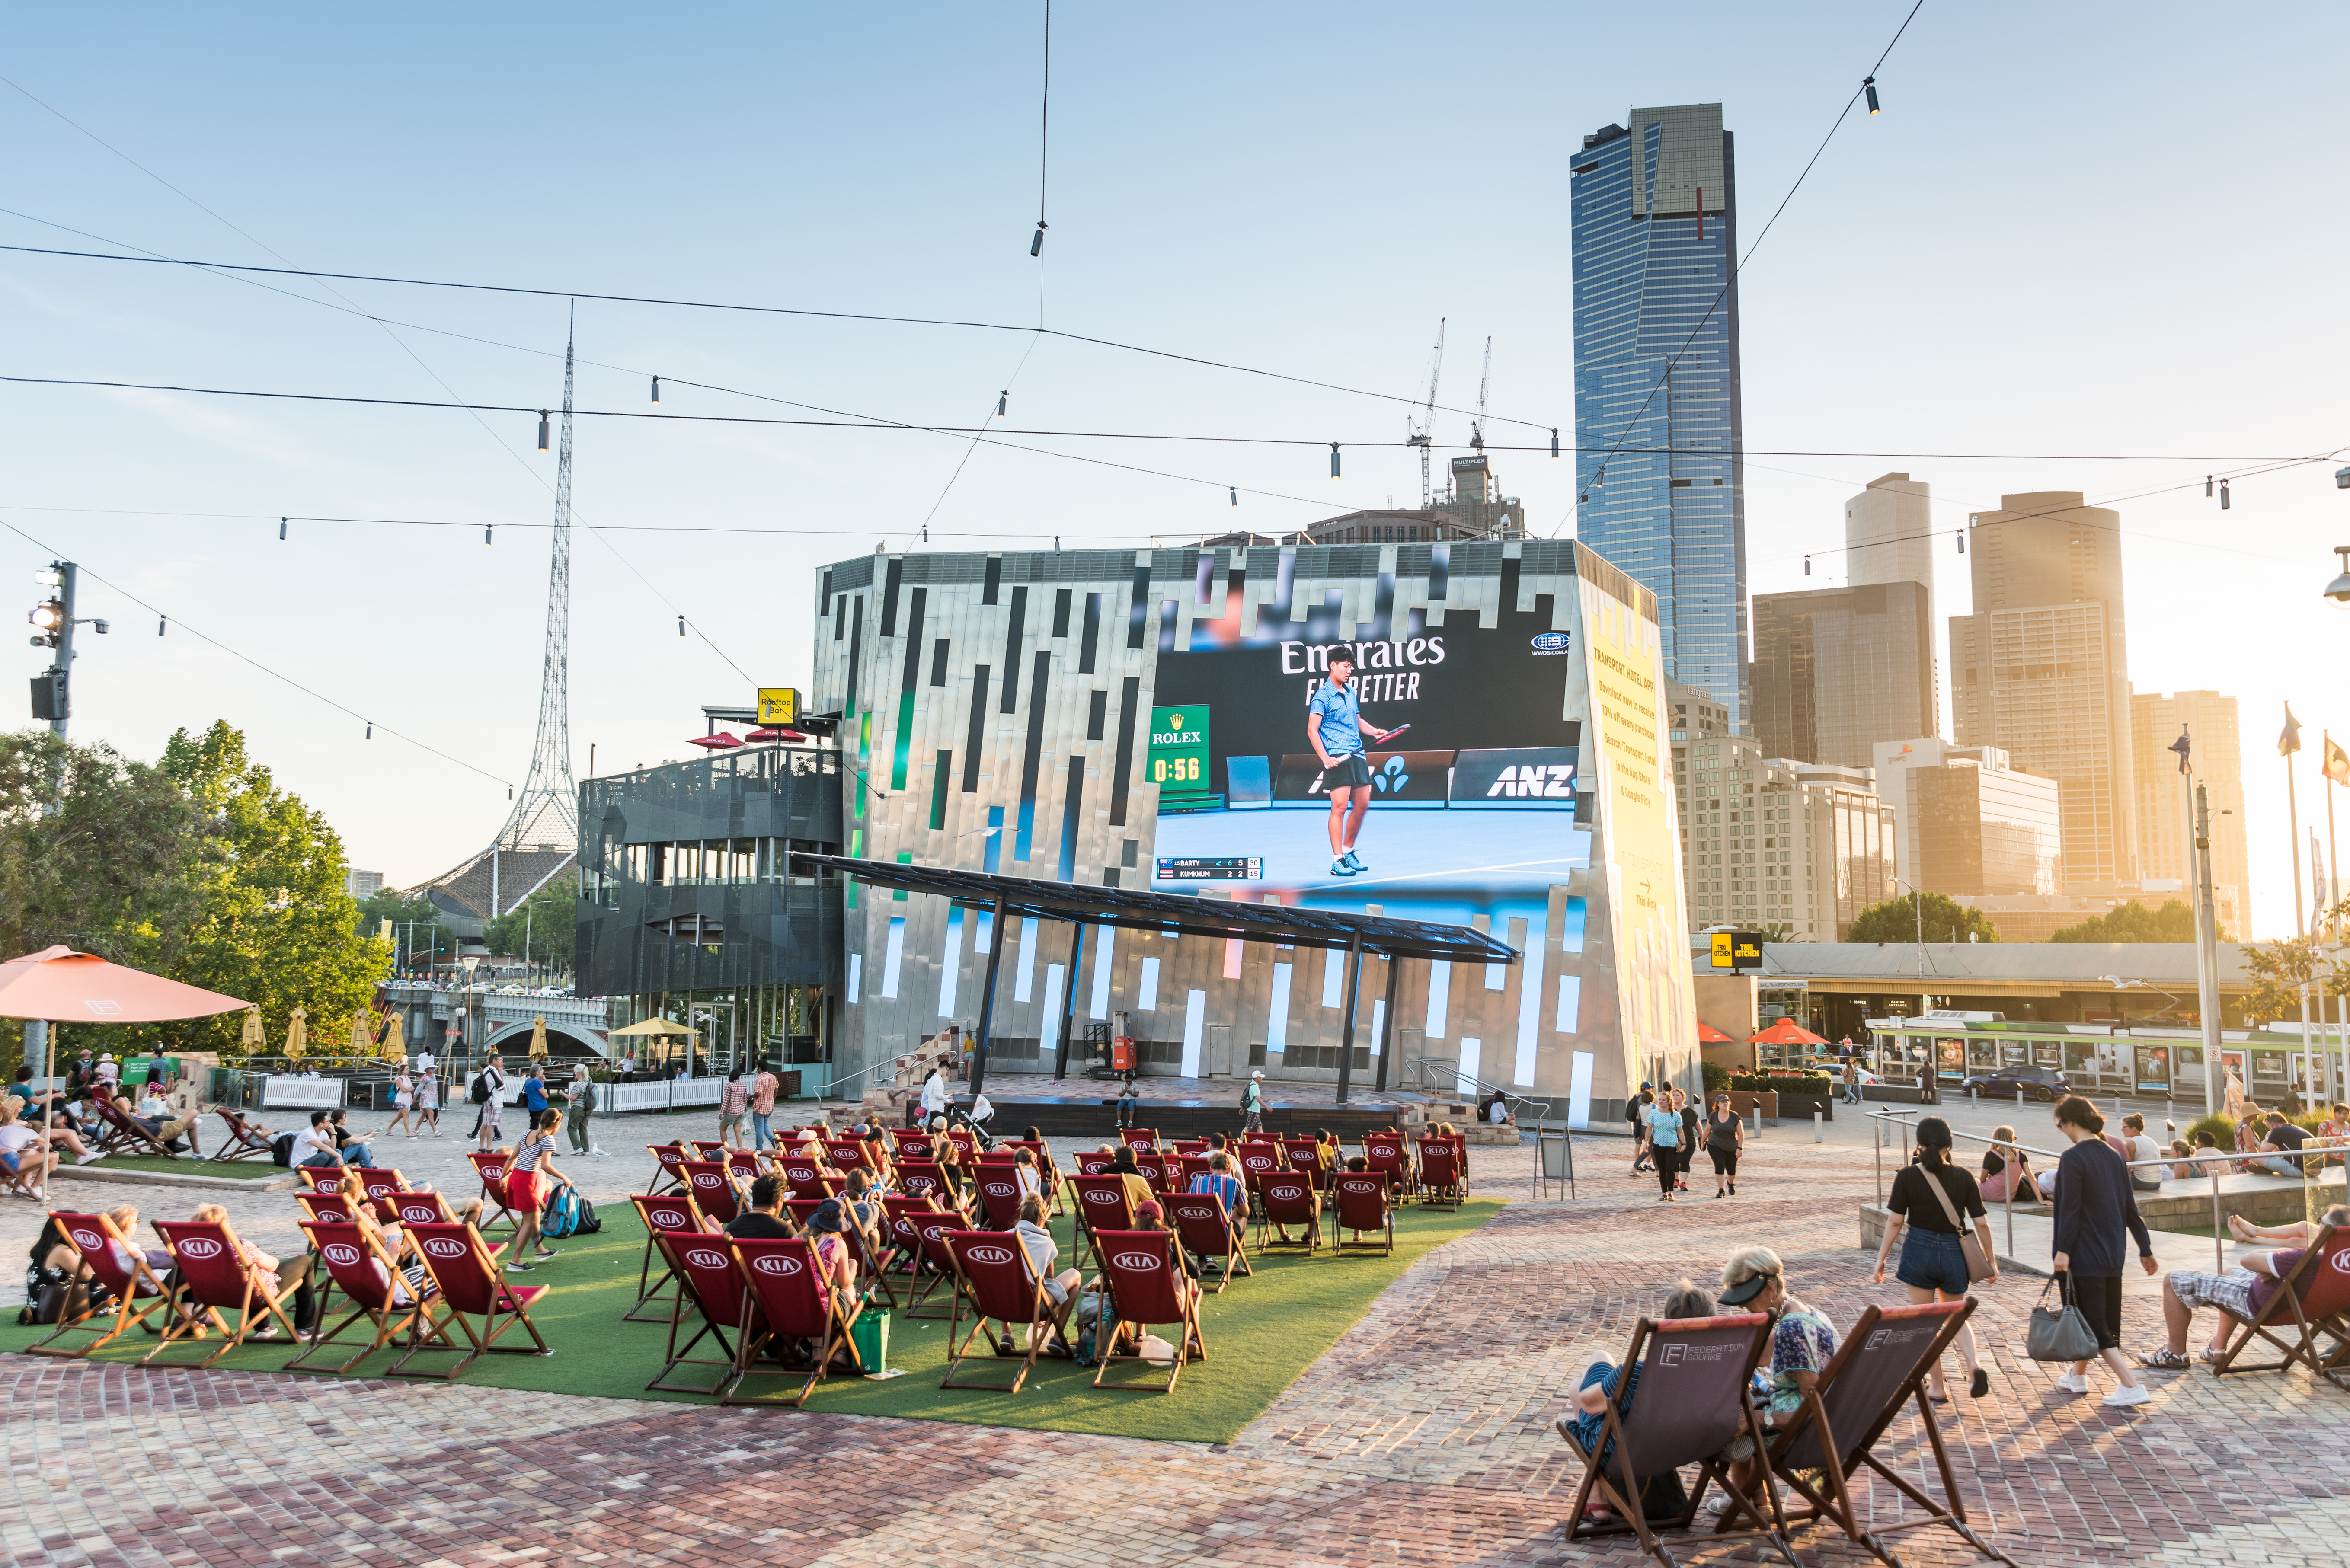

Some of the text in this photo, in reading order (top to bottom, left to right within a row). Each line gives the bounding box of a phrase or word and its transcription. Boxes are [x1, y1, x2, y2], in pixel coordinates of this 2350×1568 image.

[1970, 515, 1978, 527] f
[1551, 636, 1561, 646] 9
[1594, 647, 1654, 693] TRANSPORT HOTEL APP
[1688, 685, 1711, 699] Langham
[761, 699, 791, 707] Rooftop
[1599, 680, 1655, 719] Download now to receive
[1602, 704, 1613, 719] 10%
[1621, 718, 1634, 731] every
[1635, 723, 1655, 741] purchase
[1152, 731, 1202, 744] ROLEX
[1605, 733, 1621, 750] Search
[1888, 755, 1906, 764] pwc
[1155, 757, 1199, 782] 0:56
[1616, 760, 1621, 772] in
[1630, 770, 1638, 781] App
[1639, 771, 1650, 785] Store
[1487, 765, 1573, 797] ANZ
[1625, 787, 1640, 803] Google
[1641, 794, 1650, 808] Play
[1636, 894, 1656, 911] This Way
[697, 1176, 718, 1185] KIA
[1090, 1192, 1114, 1201] KIA
[407, 1210, 430, 1220] KIA
[656, 1214, 680, 1223] KIA
[77, 1233, 99, 1245] KIA
[185, 1242, 216, 1253] KIA
[431, 1242, 460, 1253] KIA
[329, 1248, 355, 1260] KIA
[692, 1253, 723, 1265] KIA
[975, 1249, 1006, 1260] KIA
[761, 1260, 795, 1271] KIA
[1120, 1256, 1154, 1267] KIA
[1688, 1342, 1744, 1354] FEDERATION
[1687, 1353, 1721, 1361] SQUARE
